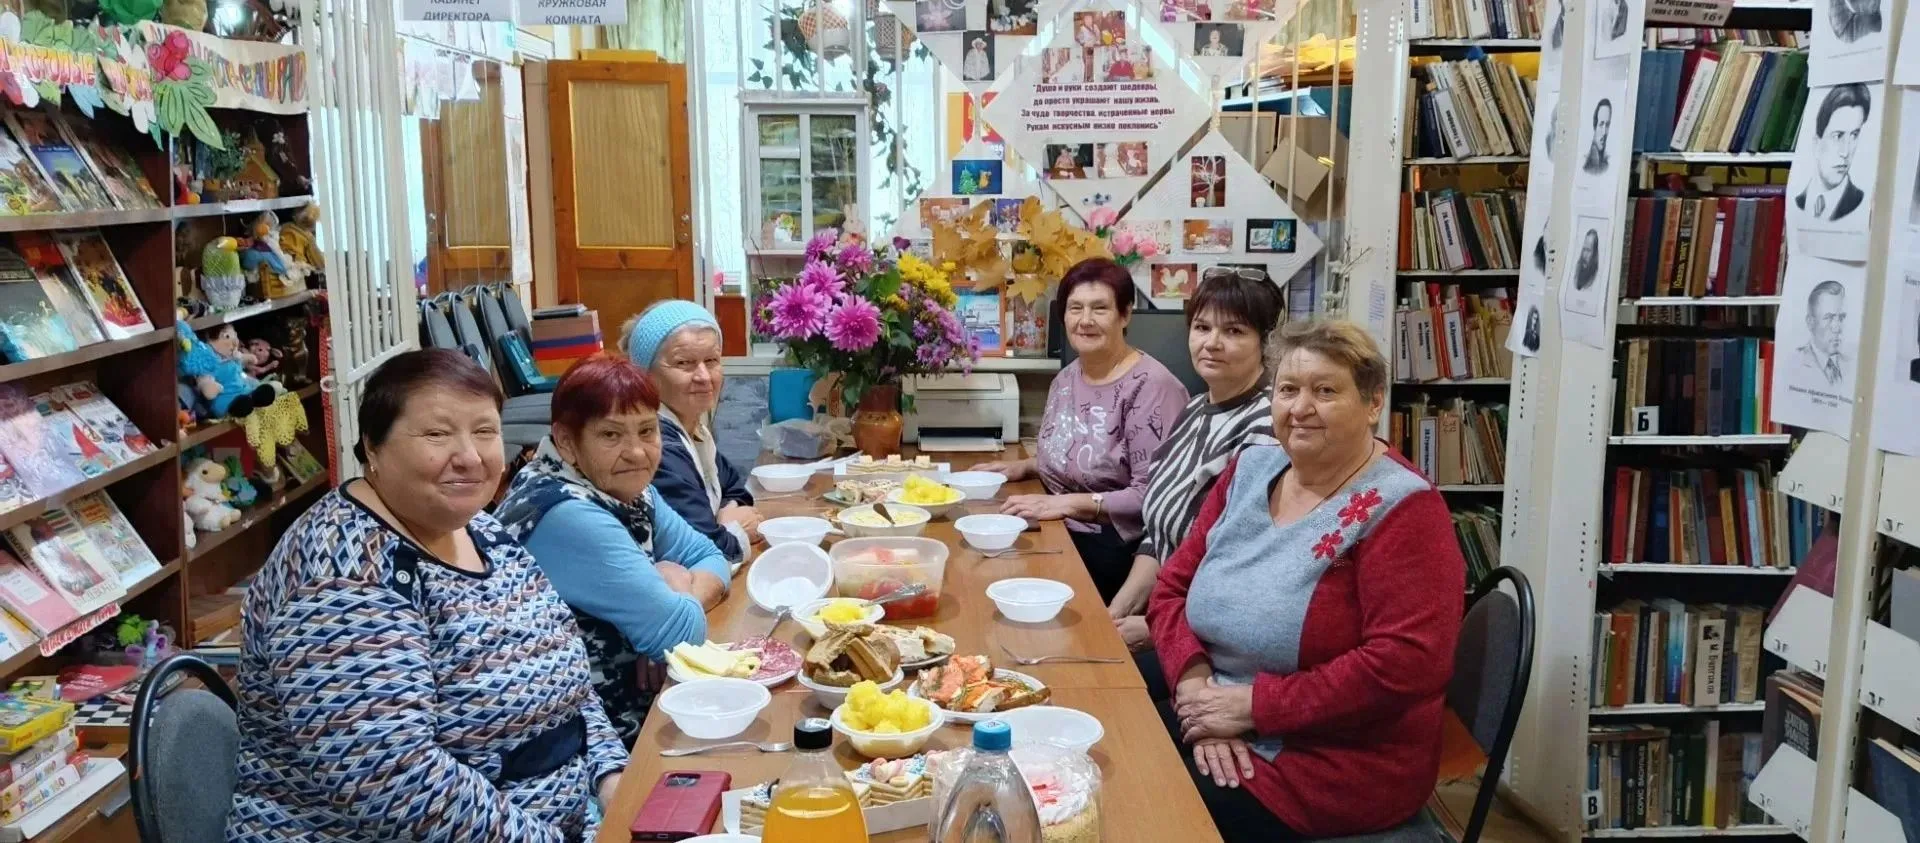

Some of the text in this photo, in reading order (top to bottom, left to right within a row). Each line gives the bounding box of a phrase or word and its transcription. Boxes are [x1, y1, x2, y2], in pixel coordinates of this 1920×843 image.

[423, 12, 491, 21] ДИРЕКТОРА
[545, 15, 601, 25] КОМНАТА
[1703, 13, 1724, 21] 16+
[1084, 84, 1117, 92] создают
[1072, 97, 1110, 105] украшают
[1114, 97, 1132, 105] нашу
[1021, 109, 1030, 117] За
[1098, 108, 1148, 117] истраченные
[1150, 107, 1175, 116] нервы
[1026, 123, 1049, 132] Рукам
[1052, 122, 1091, 131] искусным
[1093, 122, 1116, 130] низко
[1638, 412, 1649, 431] Б
[1588, 796, 1598, 815] В
